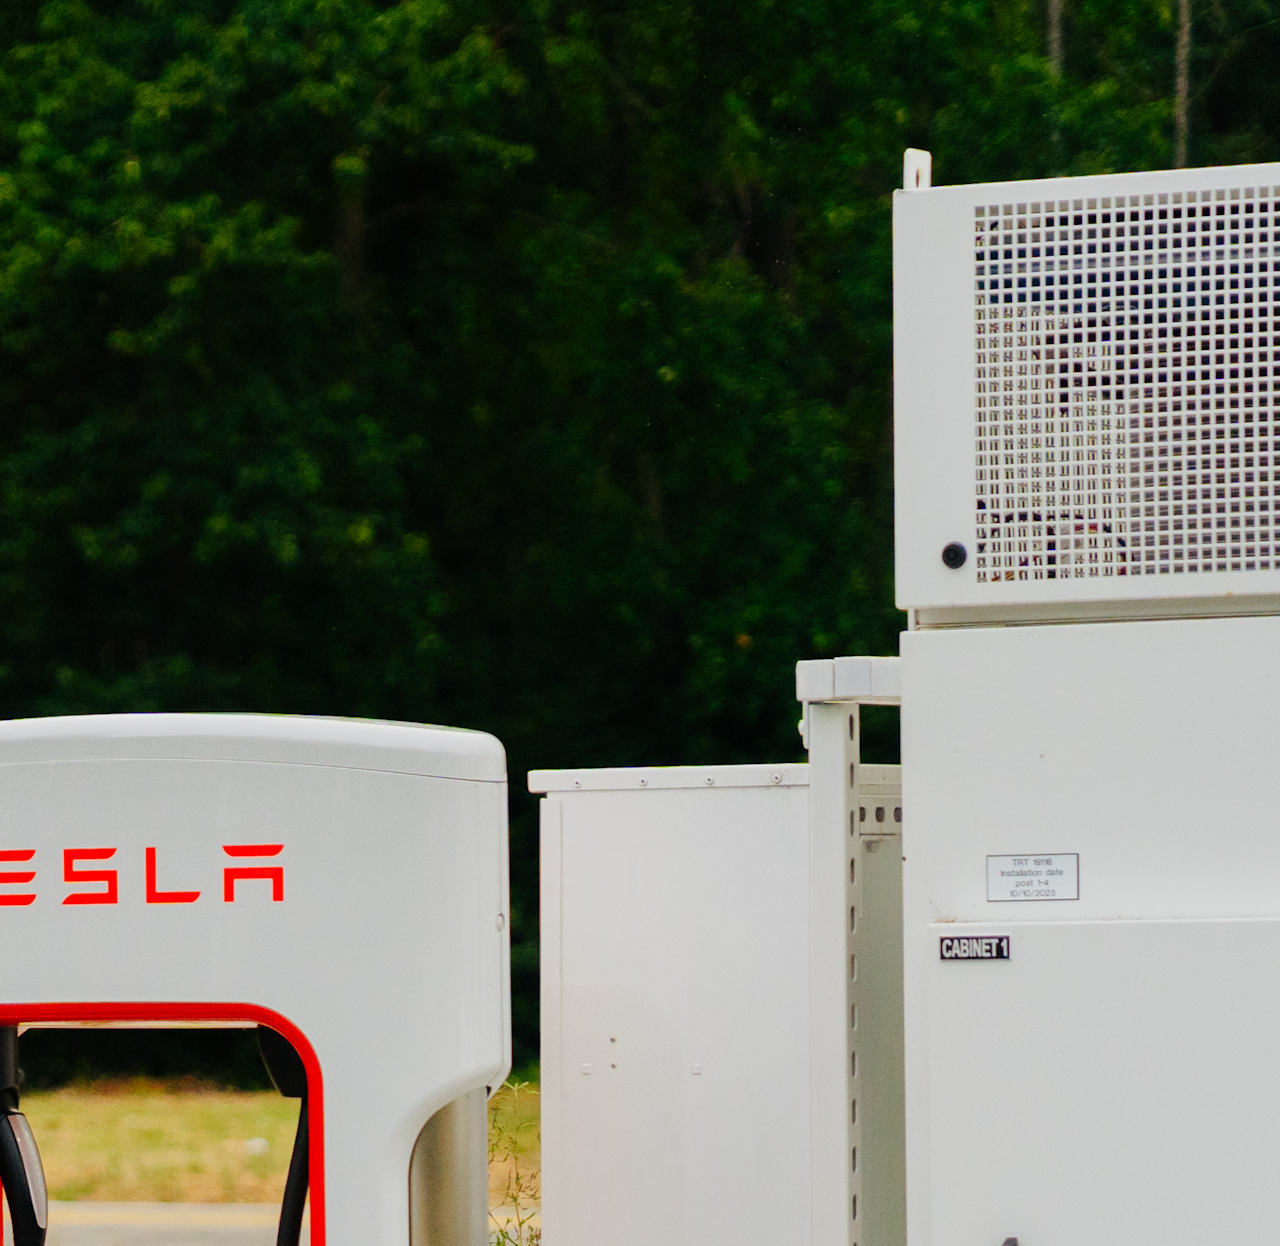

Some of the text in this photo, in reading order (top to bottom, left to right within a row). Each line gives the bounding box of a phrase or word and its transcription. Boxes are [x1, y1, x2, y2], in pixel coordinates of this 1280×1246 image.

[1045, 868, 1064, 877] date
[941, 938, 1008, 958] CABINET 1
